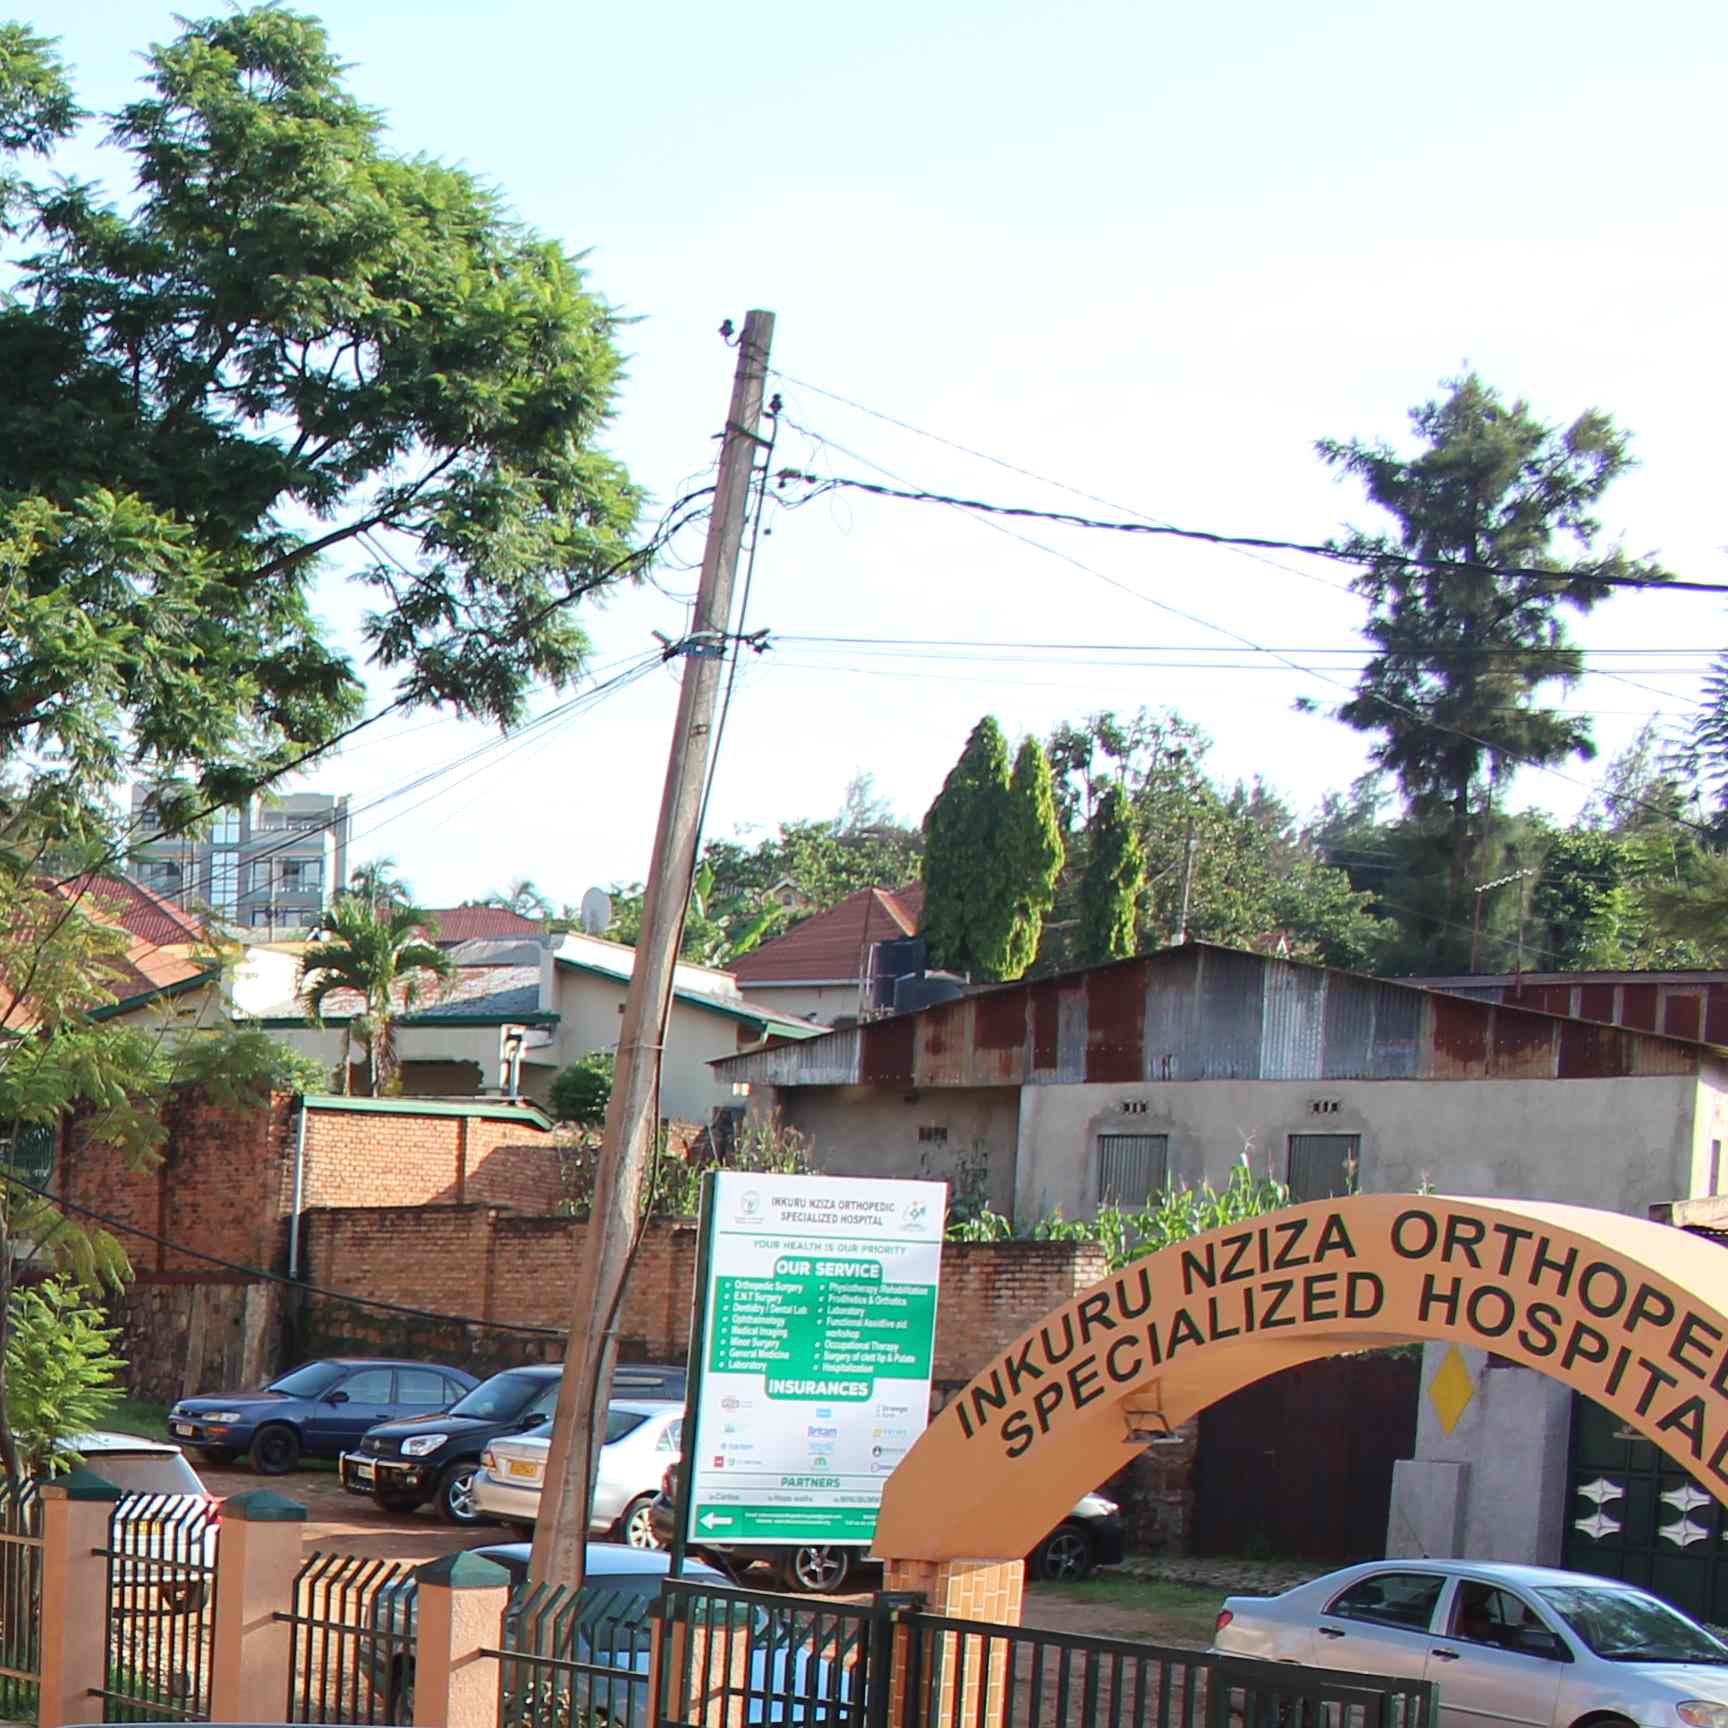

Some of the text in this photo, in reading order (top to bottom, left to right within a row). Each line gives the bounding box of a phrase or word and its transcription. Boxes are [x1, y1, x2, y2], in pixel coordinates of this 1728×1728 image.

[772, 1196, 896, 1213] INKURU NZIZA ORTHOPEDIC
[781, 1211, 838, 1225] SPECIALIZED
[840, 1213, 884, 1227] HOSPITAL
[753, 1239, 780, 1249] YOUR
[783, 1241, 822, 1252] HEALTH
[837, 1243, 858, 1253] OUR
[862, 1244, 907, 1256] PRIORITY
[776, 1260, 881, 1278] OUR SERVICE
[954, 1209, 1728, 1438] INKURU NZIZA ORTHOPE
[1000, 1270, 1384, 1459] SPECIALIZED
[768, 1379, 869, 1397] INSURANCES
[780, 1477, 841, 1489] PARTNERS
